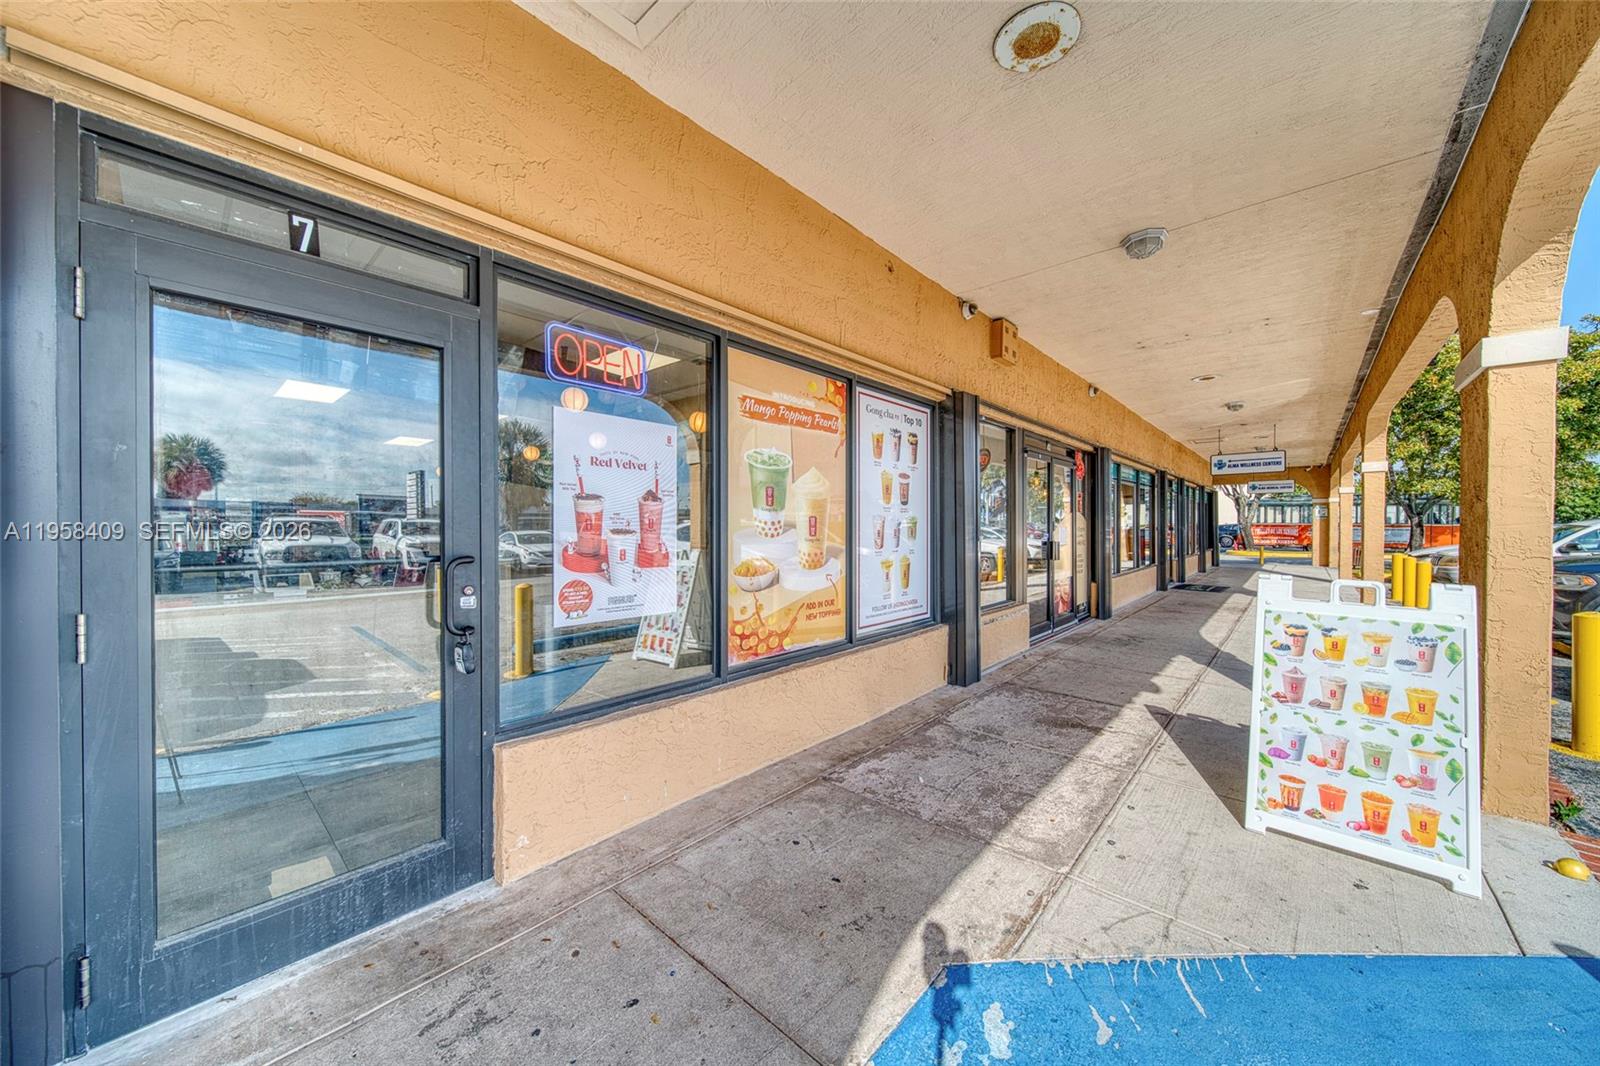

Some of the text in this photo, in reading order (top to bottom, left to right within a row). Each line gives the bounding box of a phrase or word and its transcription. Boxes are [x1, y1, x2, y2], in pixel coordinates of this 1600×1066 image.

[291, 215, 314, 253] 7
[553, 332, 641, 390] OPEN
[742, 398, 776, 419] Mango
[778, 405, 812, 427] Popping
[865, 403, 883, 419] Gong
[883, 409, 894, 418] cha
[903, 414, 915, 426] Top
[915, 417, 922, 427] 10
[590, 455, 648, 471] Red Velvet
[805, 598, 835, 610] ADD IN OUR
[805, 612, 817, 622] NEW
